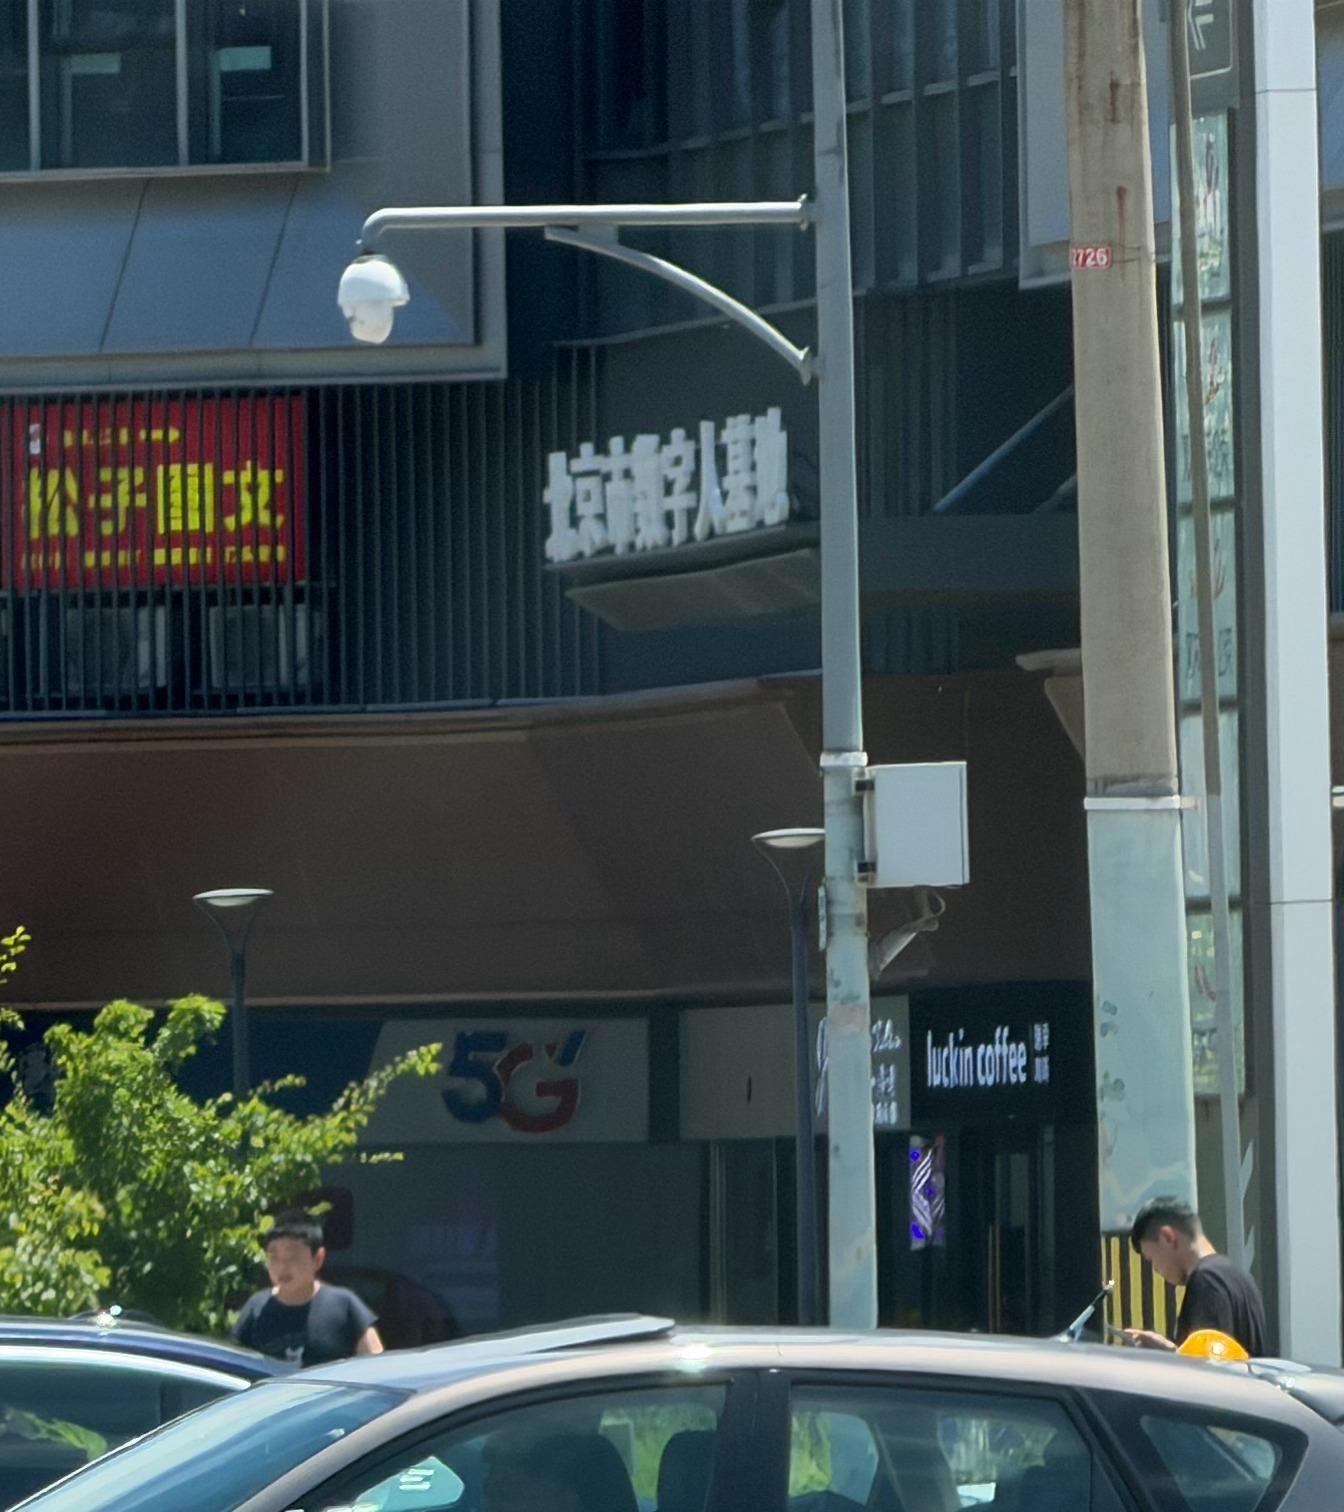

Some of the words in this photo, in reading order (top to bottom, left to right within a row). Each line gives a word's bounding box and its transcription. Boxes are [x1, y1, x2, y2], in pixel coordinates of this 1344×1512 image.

[442, 1029, 586, 1134] 5G
[927, 1028, 974, 1088] luckin
[977, 1025, 1028, 1086] coffee
